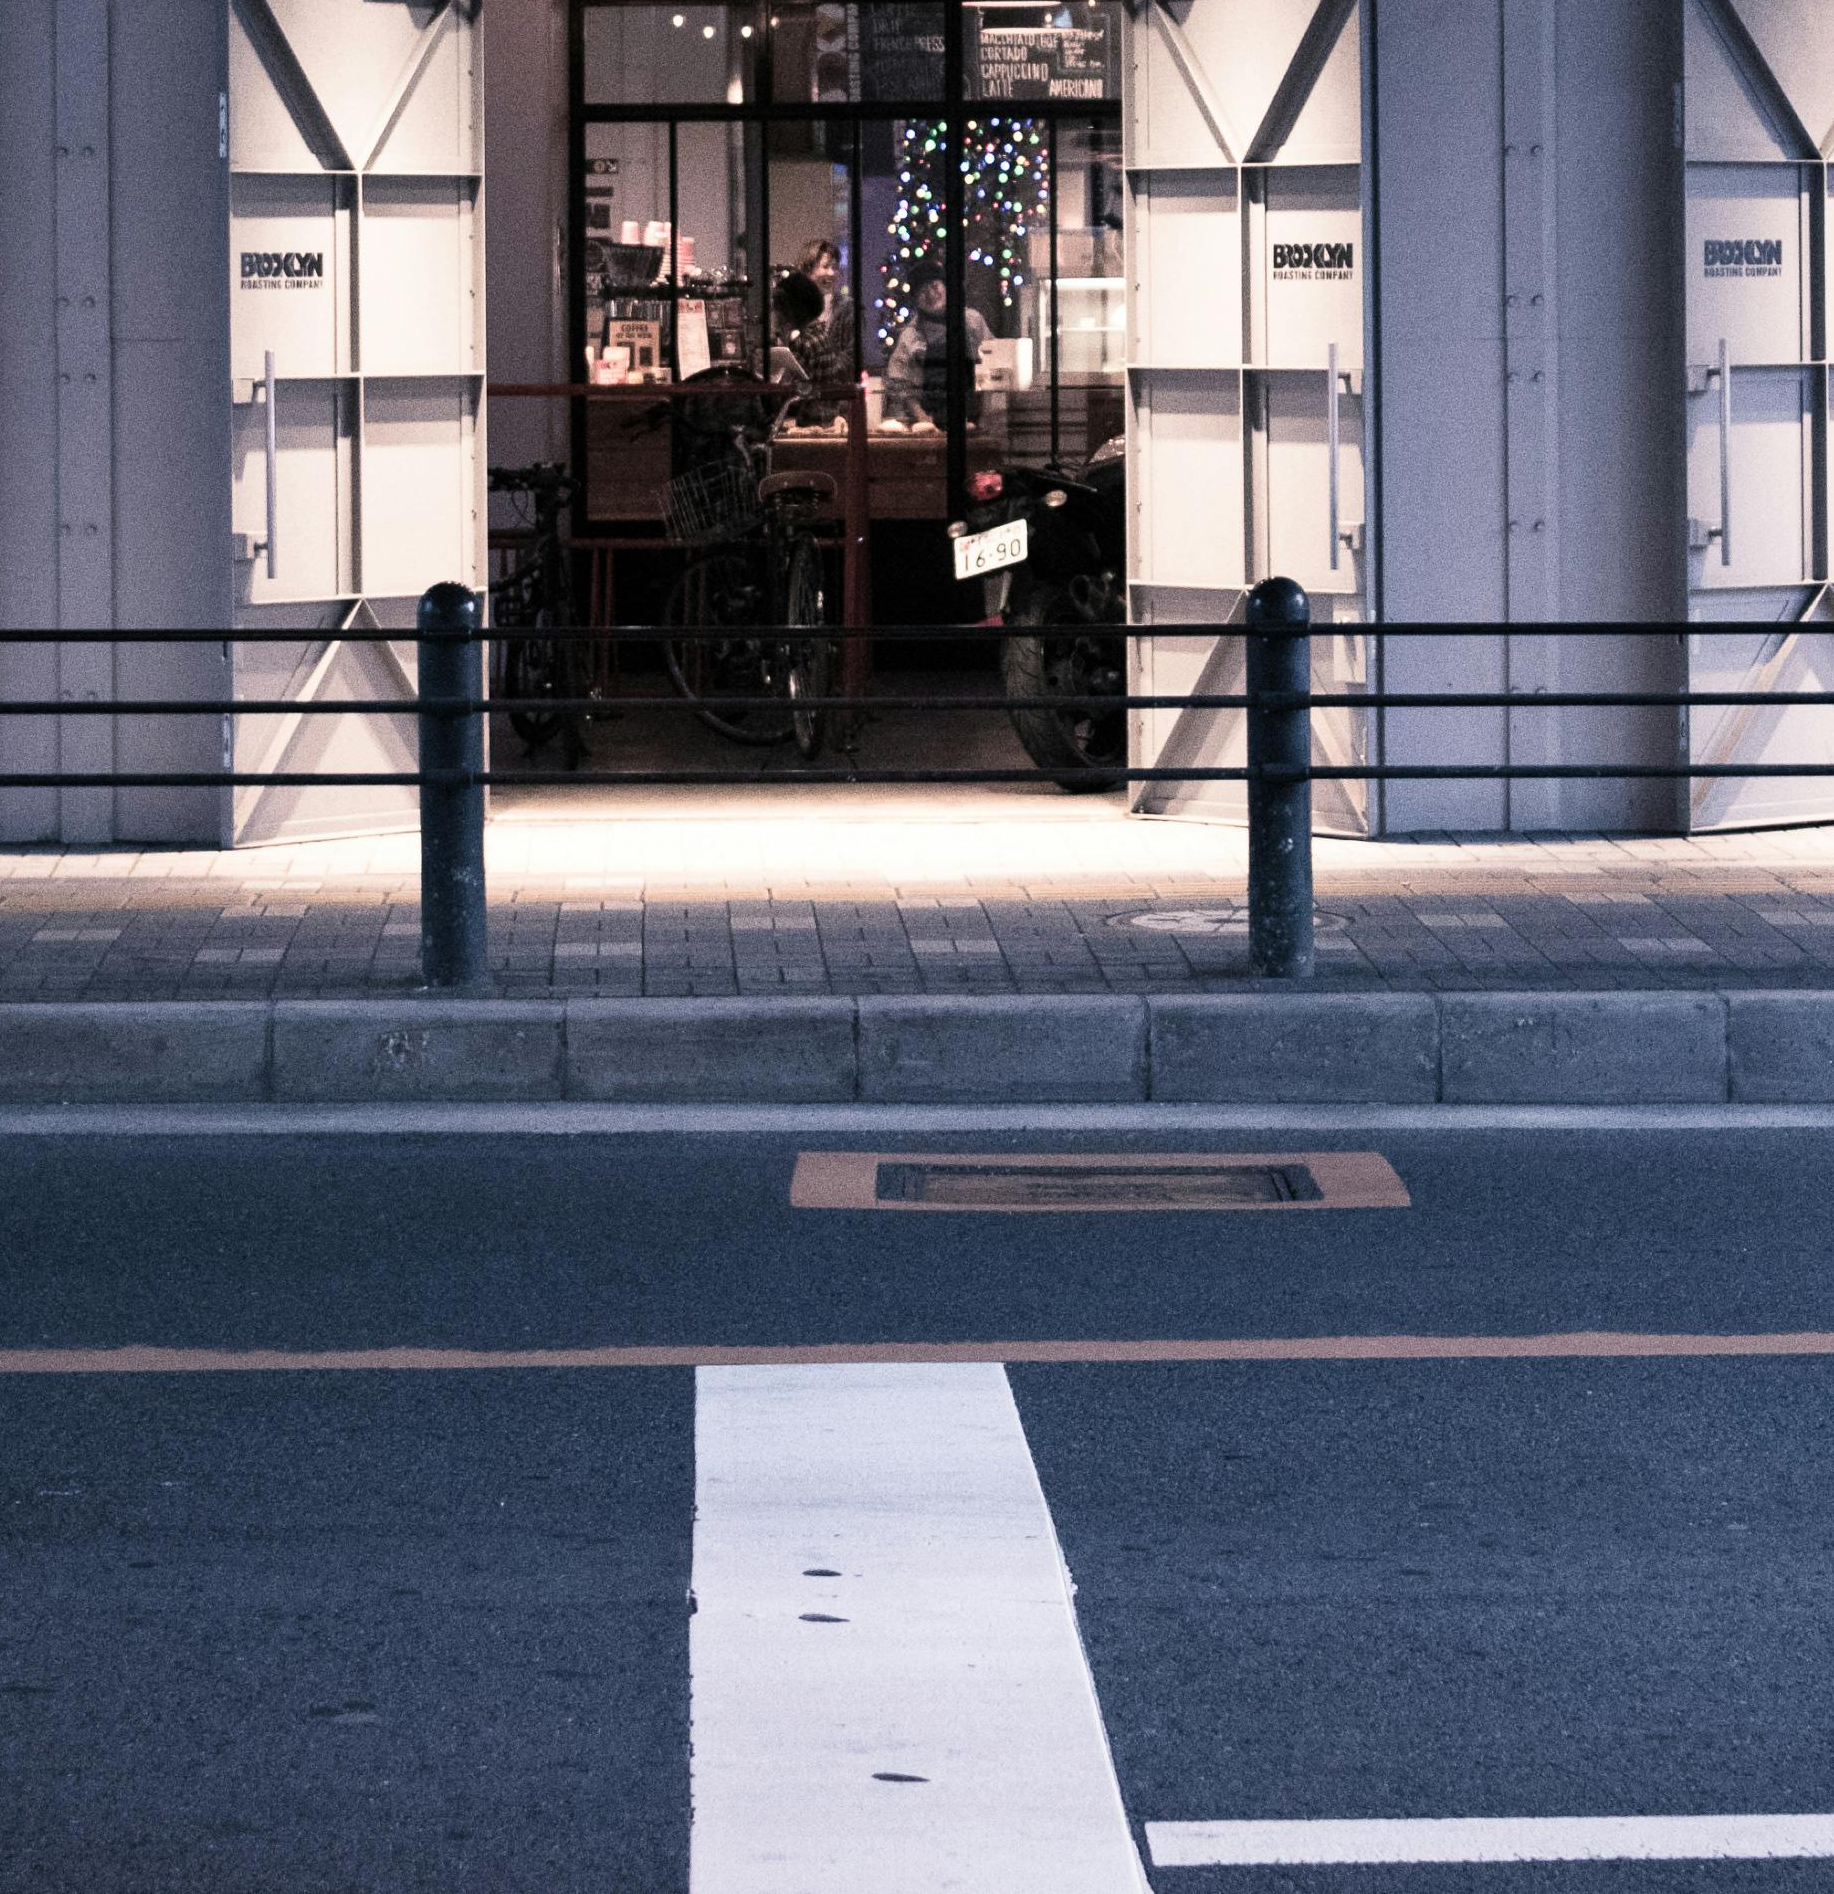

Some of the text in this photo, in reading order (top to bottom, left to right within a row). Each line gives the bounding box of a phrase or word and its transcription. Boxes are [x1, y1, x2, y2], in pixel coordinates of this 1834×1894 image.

[981, 46, 1028, 61] CORTADO
[848, 52, 861, 102] OASTING
[981, 63, 1049, 82] CAPPUCCINO
[982, 78, 1104, 98] LATTE AMERICANO
[1273, 270, 1353, 280] ROASTING COMPANY
[240, 279, 323, 290] ROASTING COMPANY
